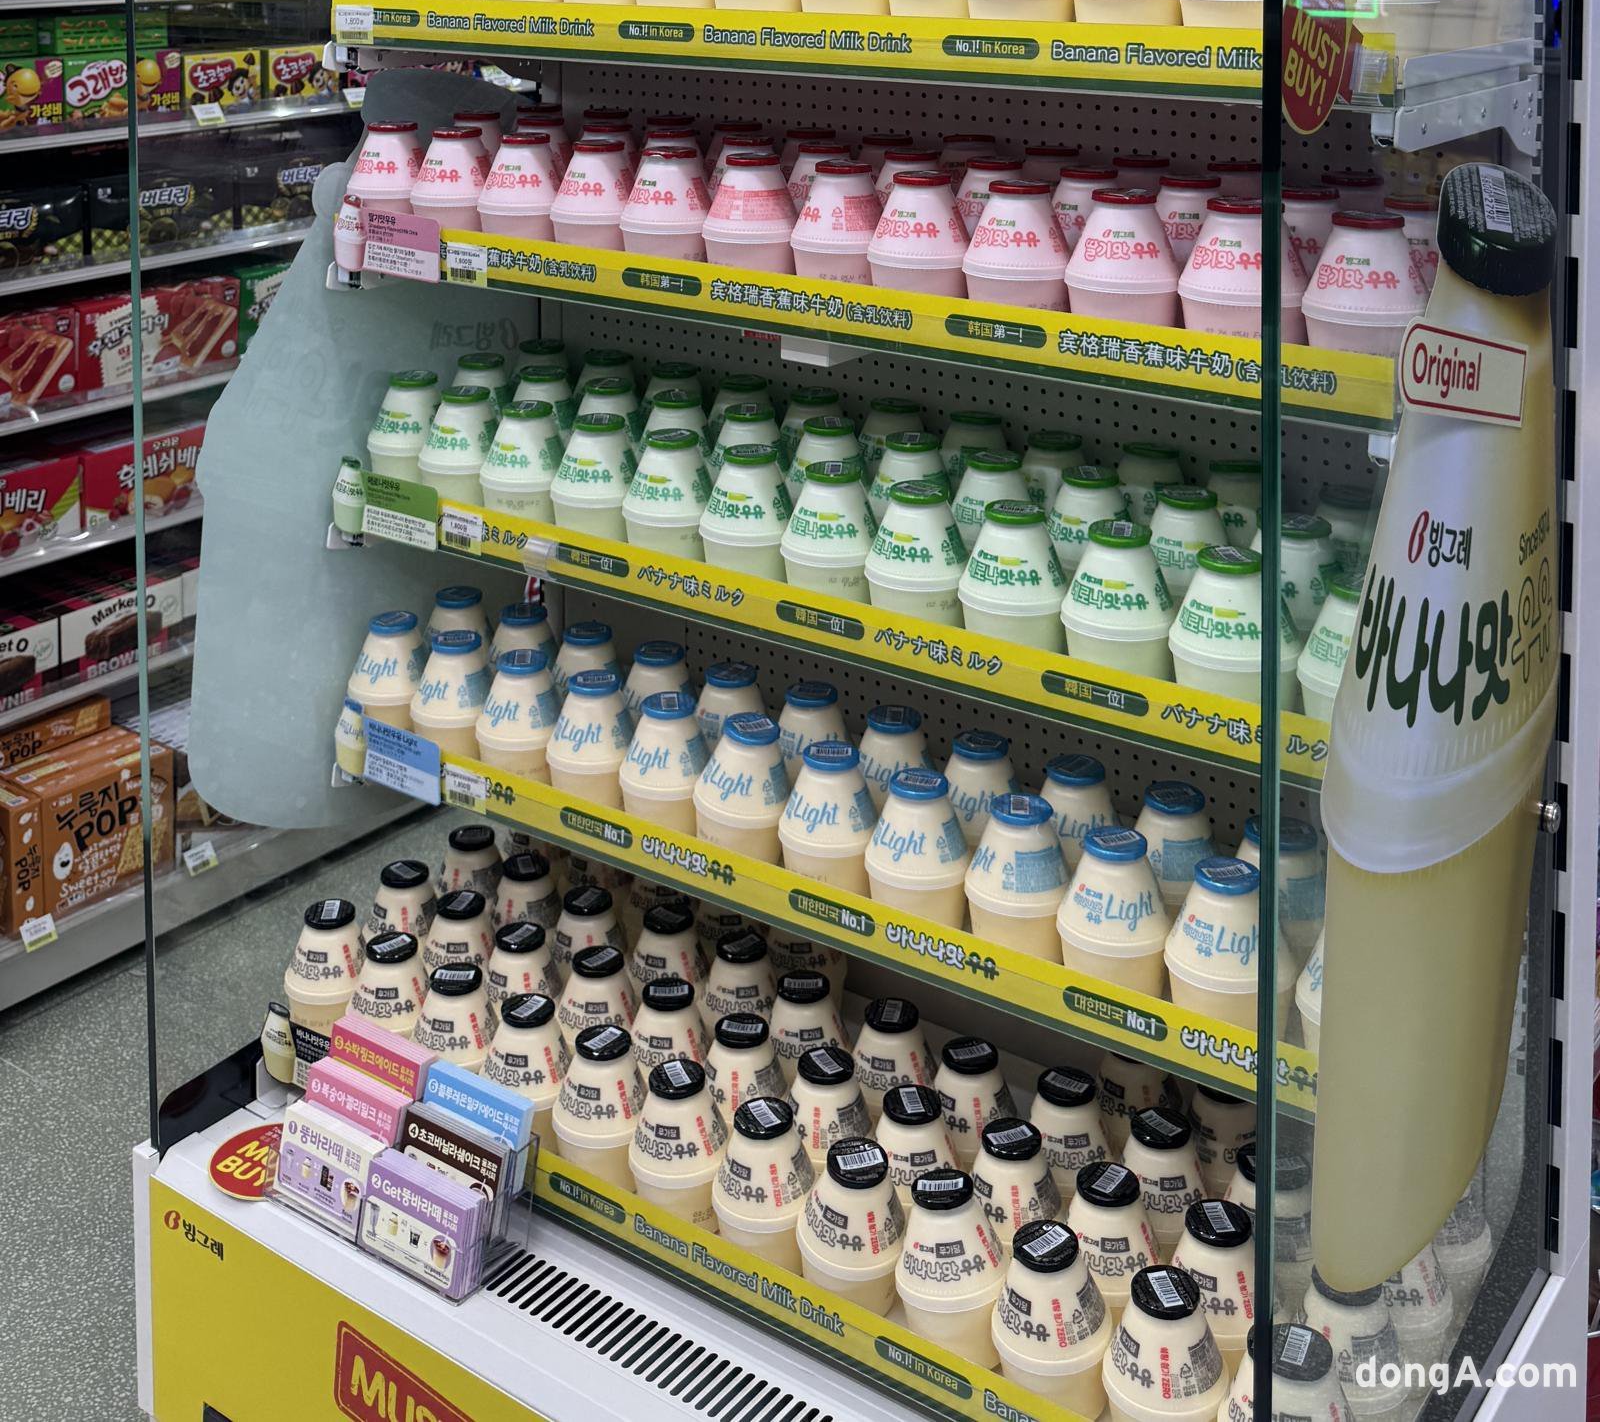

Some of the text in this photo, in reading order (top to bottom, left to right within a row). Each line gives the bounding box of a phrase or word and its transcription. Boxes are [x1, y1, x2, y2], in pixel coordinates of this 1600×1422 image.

[391, 14, 411, 24] Korea
[427, 13, 594, 37] Banana Flavored Milk Drink
[659, 27, 684, 39] Korea
[704, 26, 912, 53] Banana Flavored Milk Drink
[955, 39, 980, 54] No.1!
[994, 42, 1025, 55] Korea
[1052, 42, 1262, 70] Banana Flavored Milk
[1292, 16, 1341, 76] MUST
[69, 64, 127, 104] 고래밥
[151, 91, 180, 107] 가성비
[1284, 53, 1327, 116] BUY!
[30, 103, 62, 119] 가성비
[1084, 238, 1160, 262] 딸기맛우유
[1316, 264, 1400, 290] 딸기맛우유
[1412, 342, 1482, 399] Original
[1428, 520, 1473, 570] 빙그레
[637, 565, 745, 607] バナナ味ミルク
[361, 657, 398, 684] Light
[874, 628, 1003, 675] バナナ味ミルク
[10, 740, 42, 764] POP
[567, 719, 603, 754] Light
[631, 741, 670, 777] Light
[710, 763, 753, 800] Light
[56, 782, 119, 832] 누룽지
[73, 796, 138, 852] POP
[793, 799, 840, 834] Light
[567, 813, 736, 886] 대한민국 No.1 바나나맛우유
[880, 826, 928, 862] Light
[1104, 892, 1156, 931] Light
[797, 896, 1000, 980] 대한민국 No.1 바나나맛우유
[1215, 923, 1259, 965] Ligh
[1073, 993, 1126, 1024] 대한민국
[1126, 1009, 1156, 1036] No.1
[300, 1125, 344, 1163] 뚱바라떼
[559, 1179, 579, 1199] No.1!
[589, 1191, 615, 1217] Korea
[182, 1219, 225, 1261] 빙그레
[634, 1213, 845, 1338] Banana Flavored Milk Drink
[888, 1345, 912, 1369] No.1!
[926, 1366, 958, 1391] Korea
